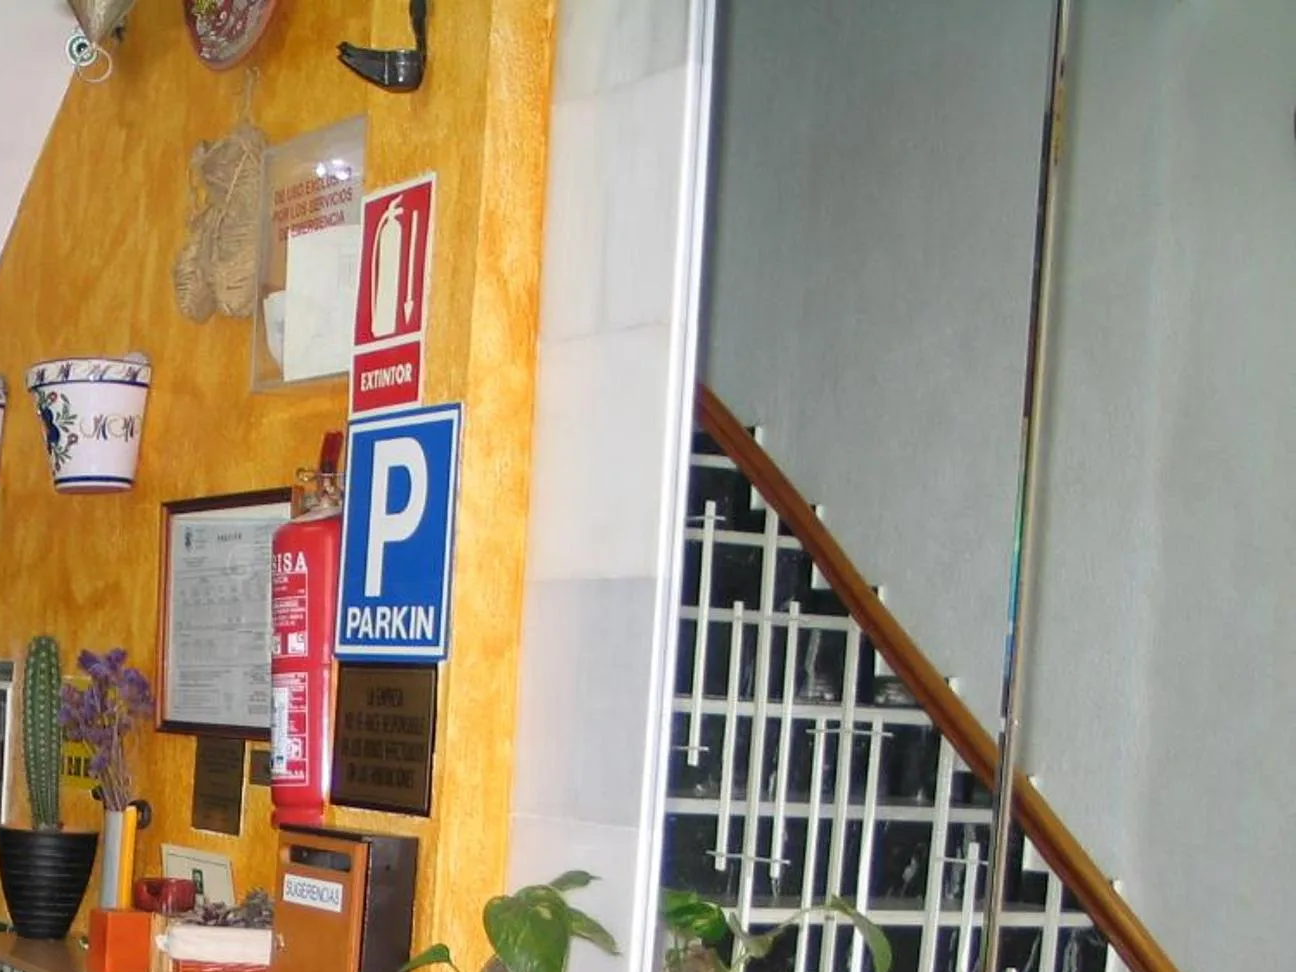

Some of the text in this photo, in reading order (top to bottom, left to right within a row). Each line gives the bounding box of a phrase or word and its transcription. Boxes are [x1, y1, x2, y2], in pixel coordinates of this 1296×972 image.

[360, 362, 413, 392] EXTINTOR
[364, 436, 429, 598] P
[346, 605, 435, 641] PARKIN
